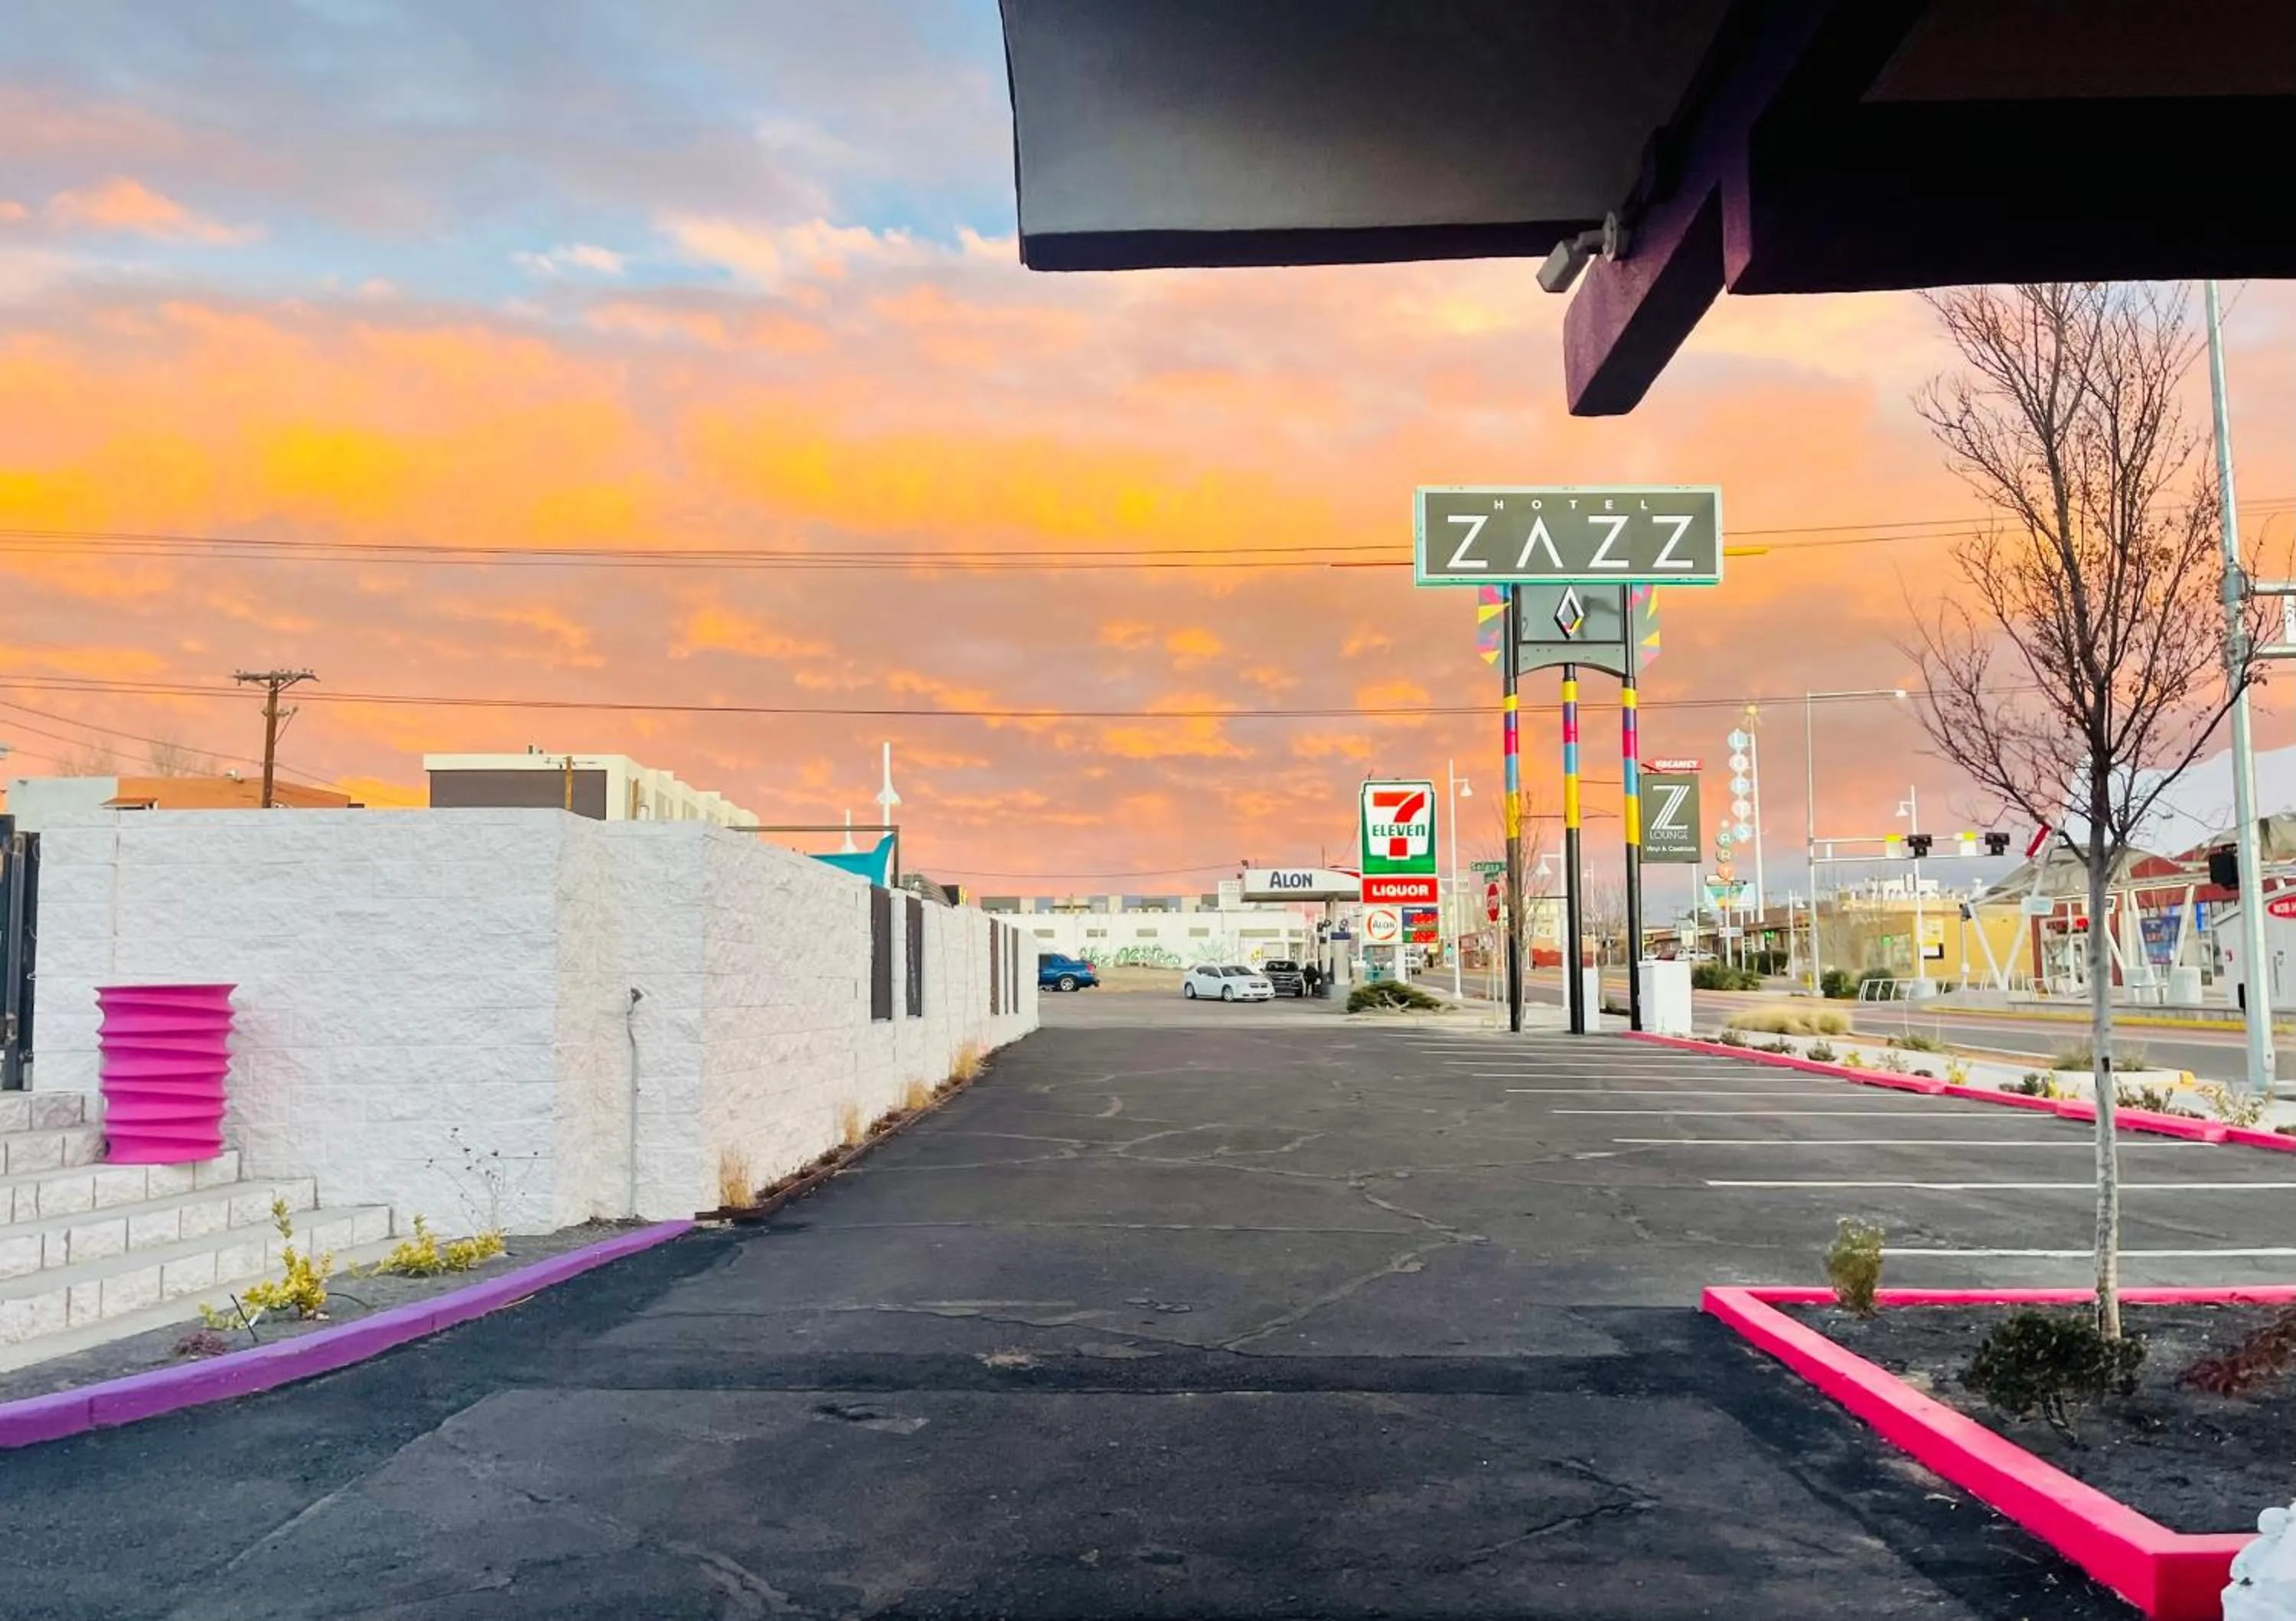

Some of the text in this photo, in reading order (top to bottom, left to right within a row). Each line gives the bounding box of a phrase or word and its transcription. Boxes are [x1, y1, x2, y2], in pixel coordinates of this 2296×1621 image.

[1493, 499, 1649, 510] HOTEL
[1446, 514, 1694, 569] ZAZZ
[1655, 758, 1698, 768] VACANCY
[1650, 784, 1691, 830] Z
[1373, 791, 1425, 857] 7
[1649, 830, 1688, 840] LOUNGE
[1269, 871, 1313, 889] ALON
[1371, 883, 1430, 897] LIQUOR
[1372, 920, 1395, 929] ALON
